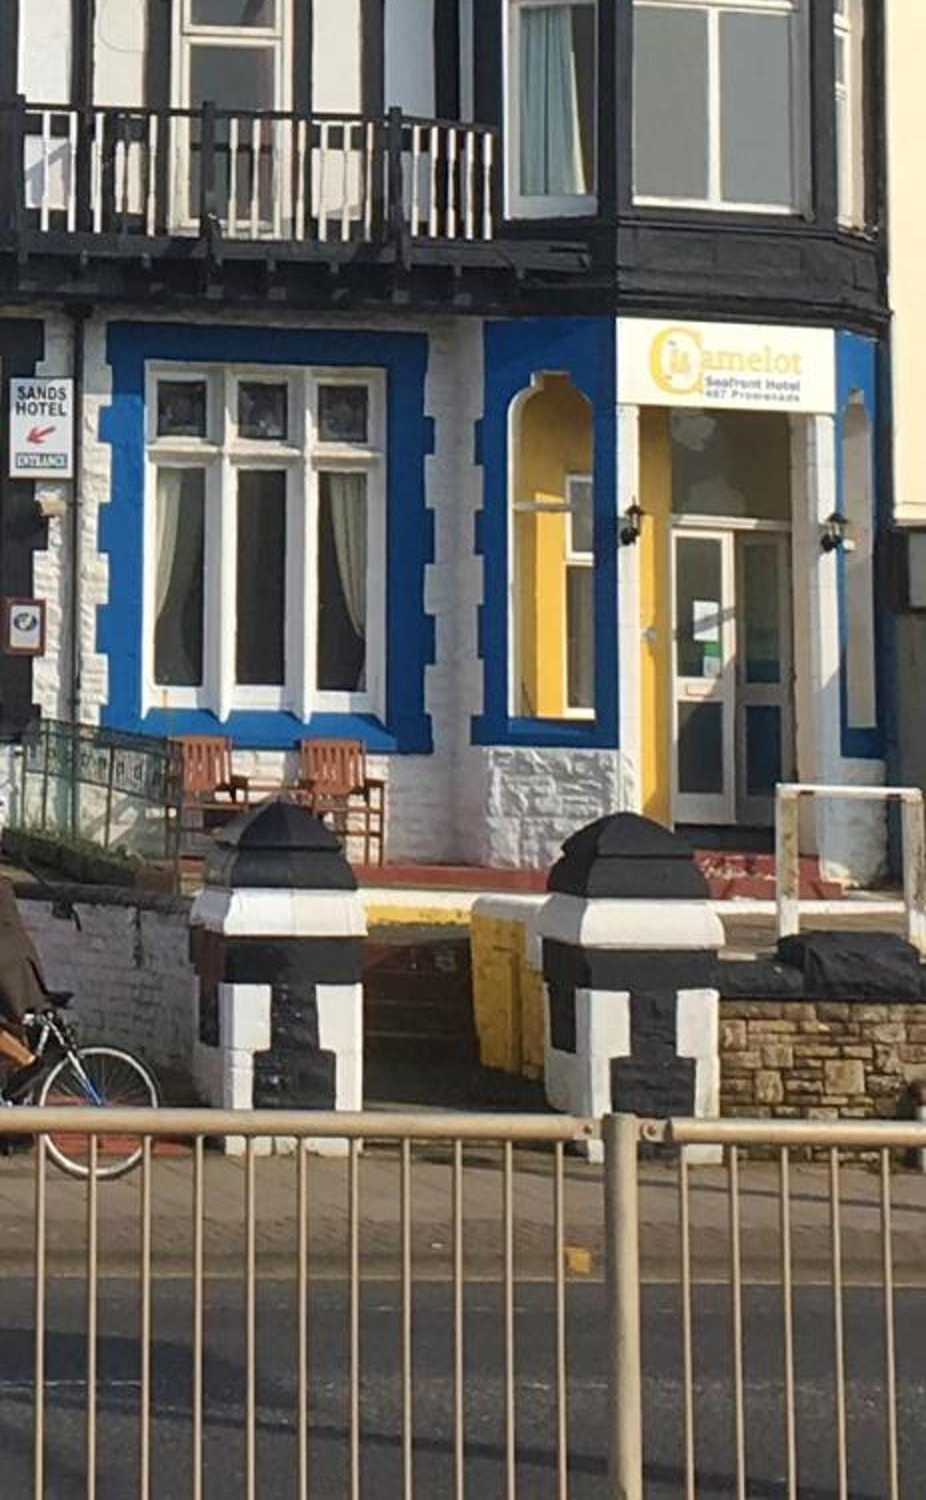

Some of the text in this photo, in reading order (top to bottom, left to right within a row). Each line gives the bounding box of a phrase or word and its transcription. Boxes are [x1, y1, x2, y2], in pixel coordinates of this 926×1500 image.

[649, 326, 803, 395] Camelot
[705, 375, 801, 392] Seafront Hotel
[16, 385, 67, 400] SANDS
[731, 391, 801, 403] Promenade
[15, 402, 67, 416] HOTEL
